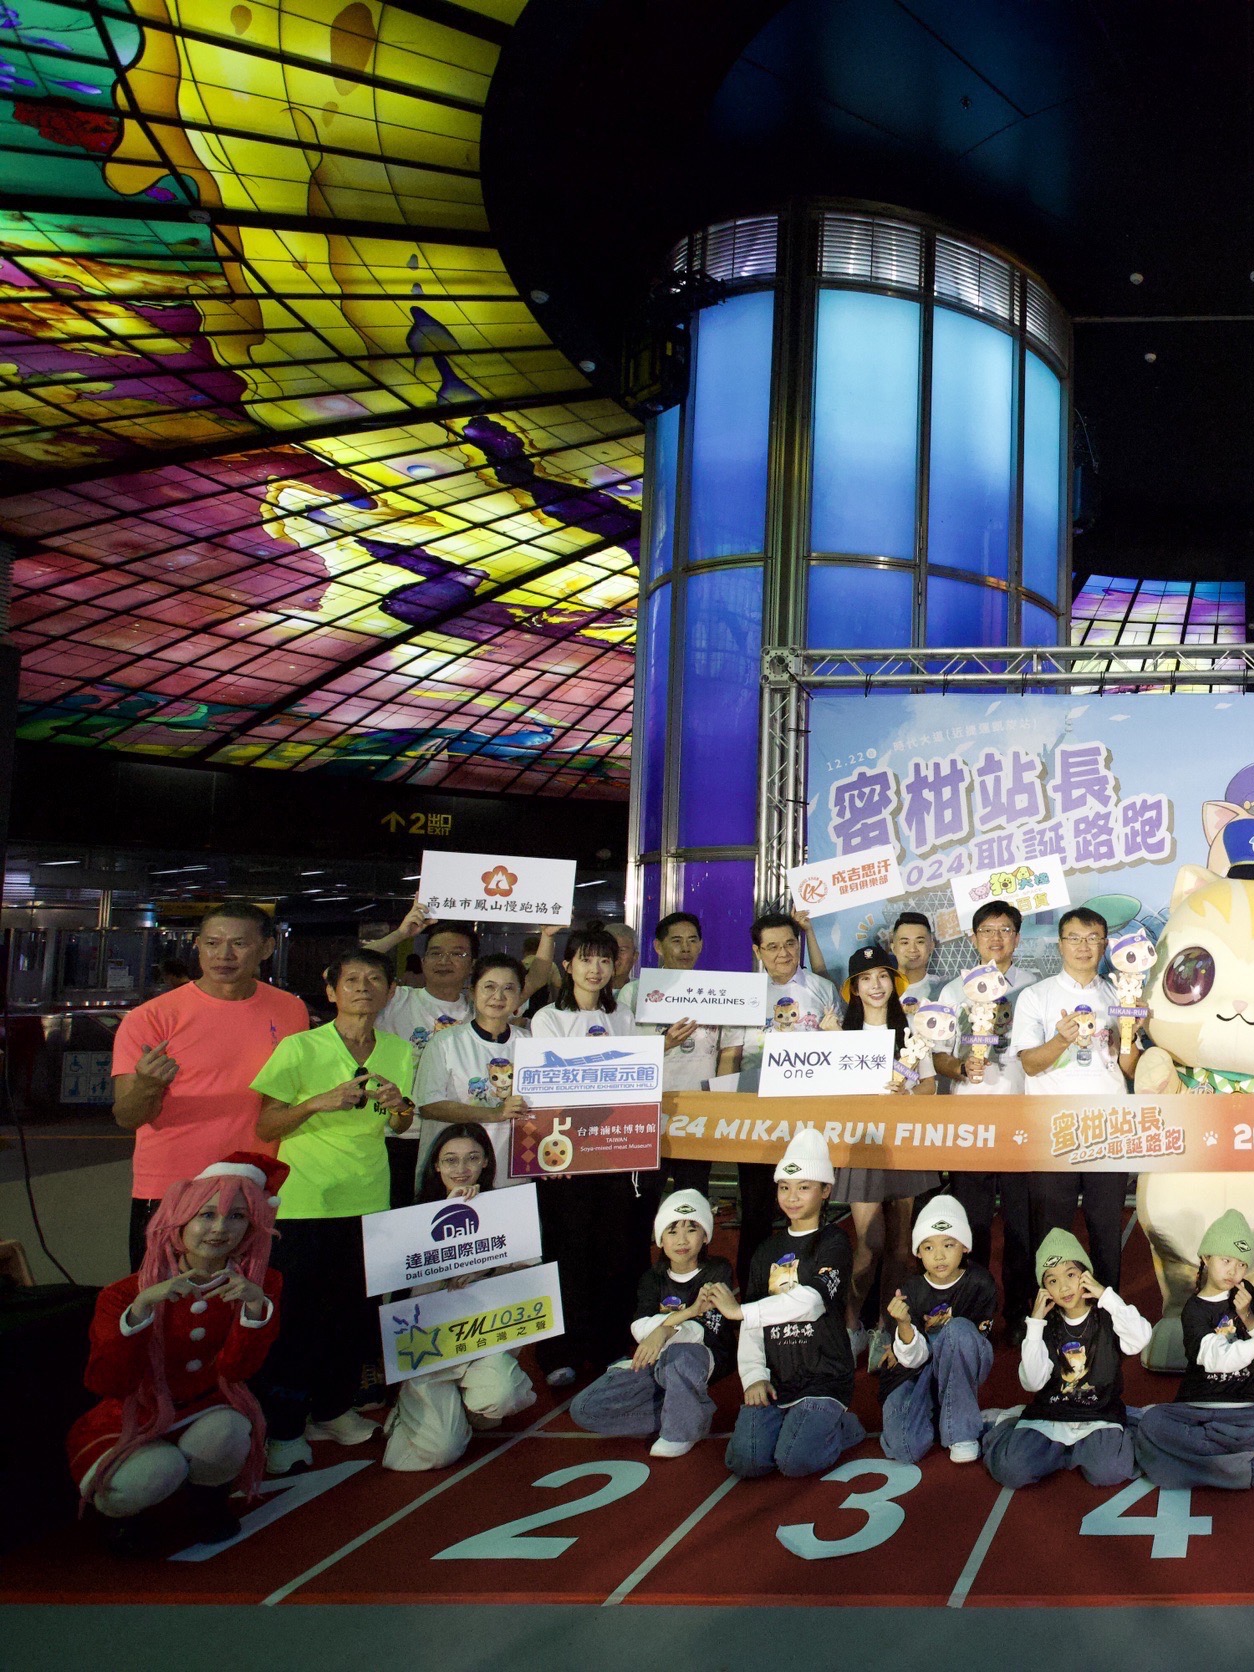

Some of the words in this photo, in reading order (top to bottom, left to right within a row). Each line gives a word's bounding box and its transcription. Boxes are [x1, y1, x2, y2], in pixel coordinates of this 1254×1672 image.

[826, 752, 865, 772] 12.22
[833, 745, 1114, 854] 蜜柑站長
[409, 813, 426, 834] 2
[428, 814, 452, 827] 出口
[428, 827, 451, 836] EXIT
[900, 852, 964, 889] 024
[973, 799, 1169, 870] 耶誕路跑
[832, 859, 892, 886] 成吉思汗
[839, 874, 889, 895] 健身俱樂部
[427, 896, 563, 915] 高雄市鳳山慢跑協會
[665, 996, 698, 1004] CHINA
[700, 997, 745, 1005] AIRLINES
[687, 987, 727, 997] 中華航空
[1109, 1007, 1148, 1017] MIKAN-RUN
[961, 1035, 999, 1044] MIKAN-RUN
[768, 1049, 832, 1068] NANOX
[838, 1053, 887, 1071] 奈米樂
[522, 1066, 655, 1085] 航空教育展示館
[784, 1067, 814, 1079] one
[577, 1123, 657, 1137] 台灣滷味博物館
[823, 1121, 885, 1145] RUN
[894, 1122, 996, 1148] FINISH
[1053, 1106, 1162, 1153] 蜜柑站長
[1072, 1146, 1103, 1161] 2024
[1107, 1128, 1183, 1155] 耶誕路跑
[443, 1218, 476, 1241] Dali
[405, 1234, 507, 1270] 達麗國際團隊
[405, 1270, 423, 1281] Dali
[425, 1263, 453, 1277] Global
[453, 1251, 508, 1271] Development
[448, 1316, 487, 1342] FM
[490, 1302, 544, 1329] 103.9
[455, 1320, 547, 1354] 南台灣之聲
[430, 1460, 650, 1561] 2
[775, 1459, 922, 1561] 3
[1079, 1474, 1212, 1559] 4
